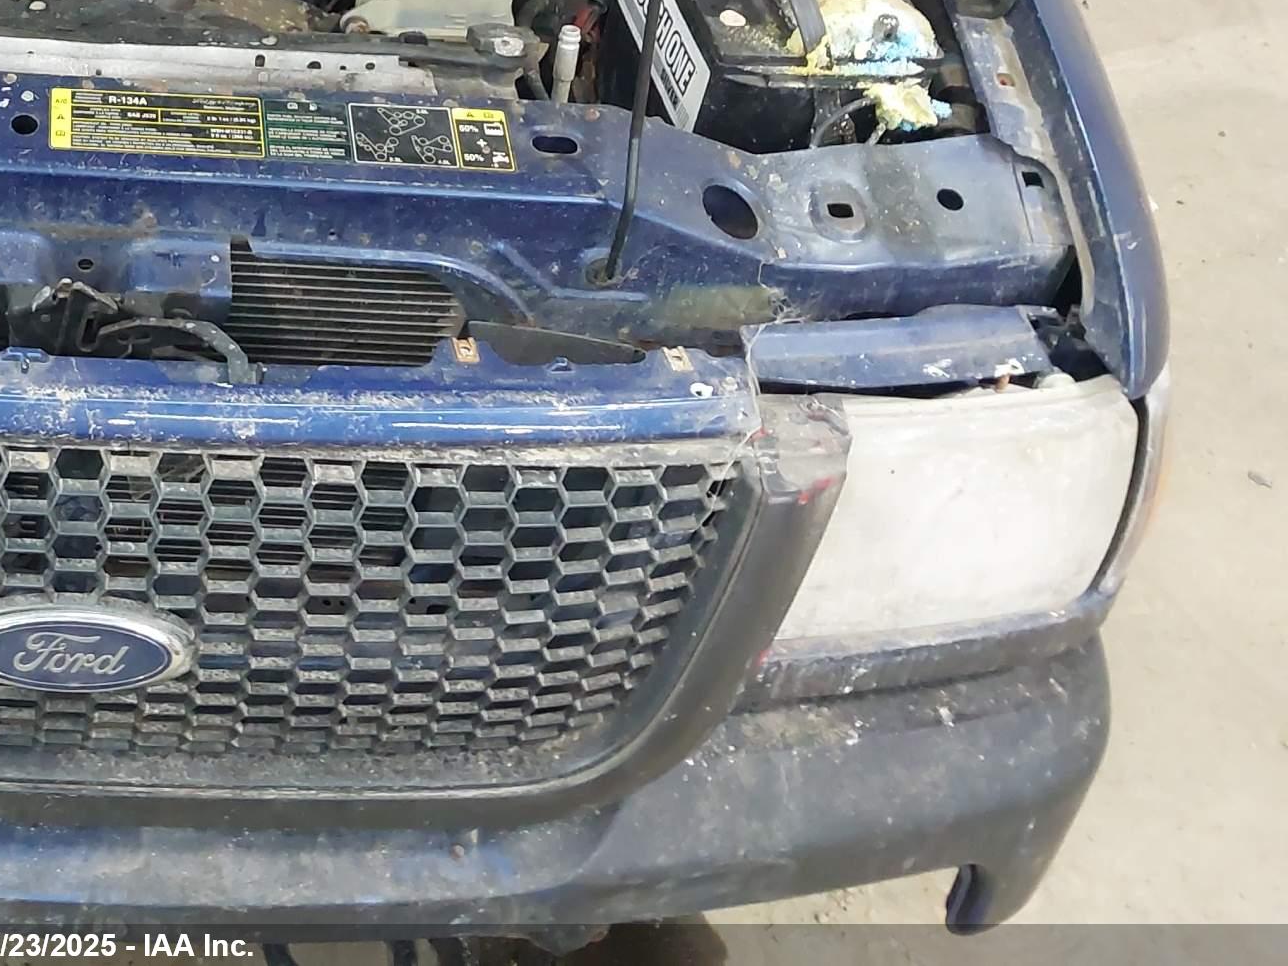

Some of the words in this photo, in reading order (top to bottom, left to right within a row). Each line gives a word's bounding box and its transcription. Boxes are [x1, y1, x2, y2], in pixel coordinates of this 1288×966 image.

[665, 31, 696, 96] ONE
[108, 95, 148, 106] R-134A
[13, 631, 130, 675] Ford
